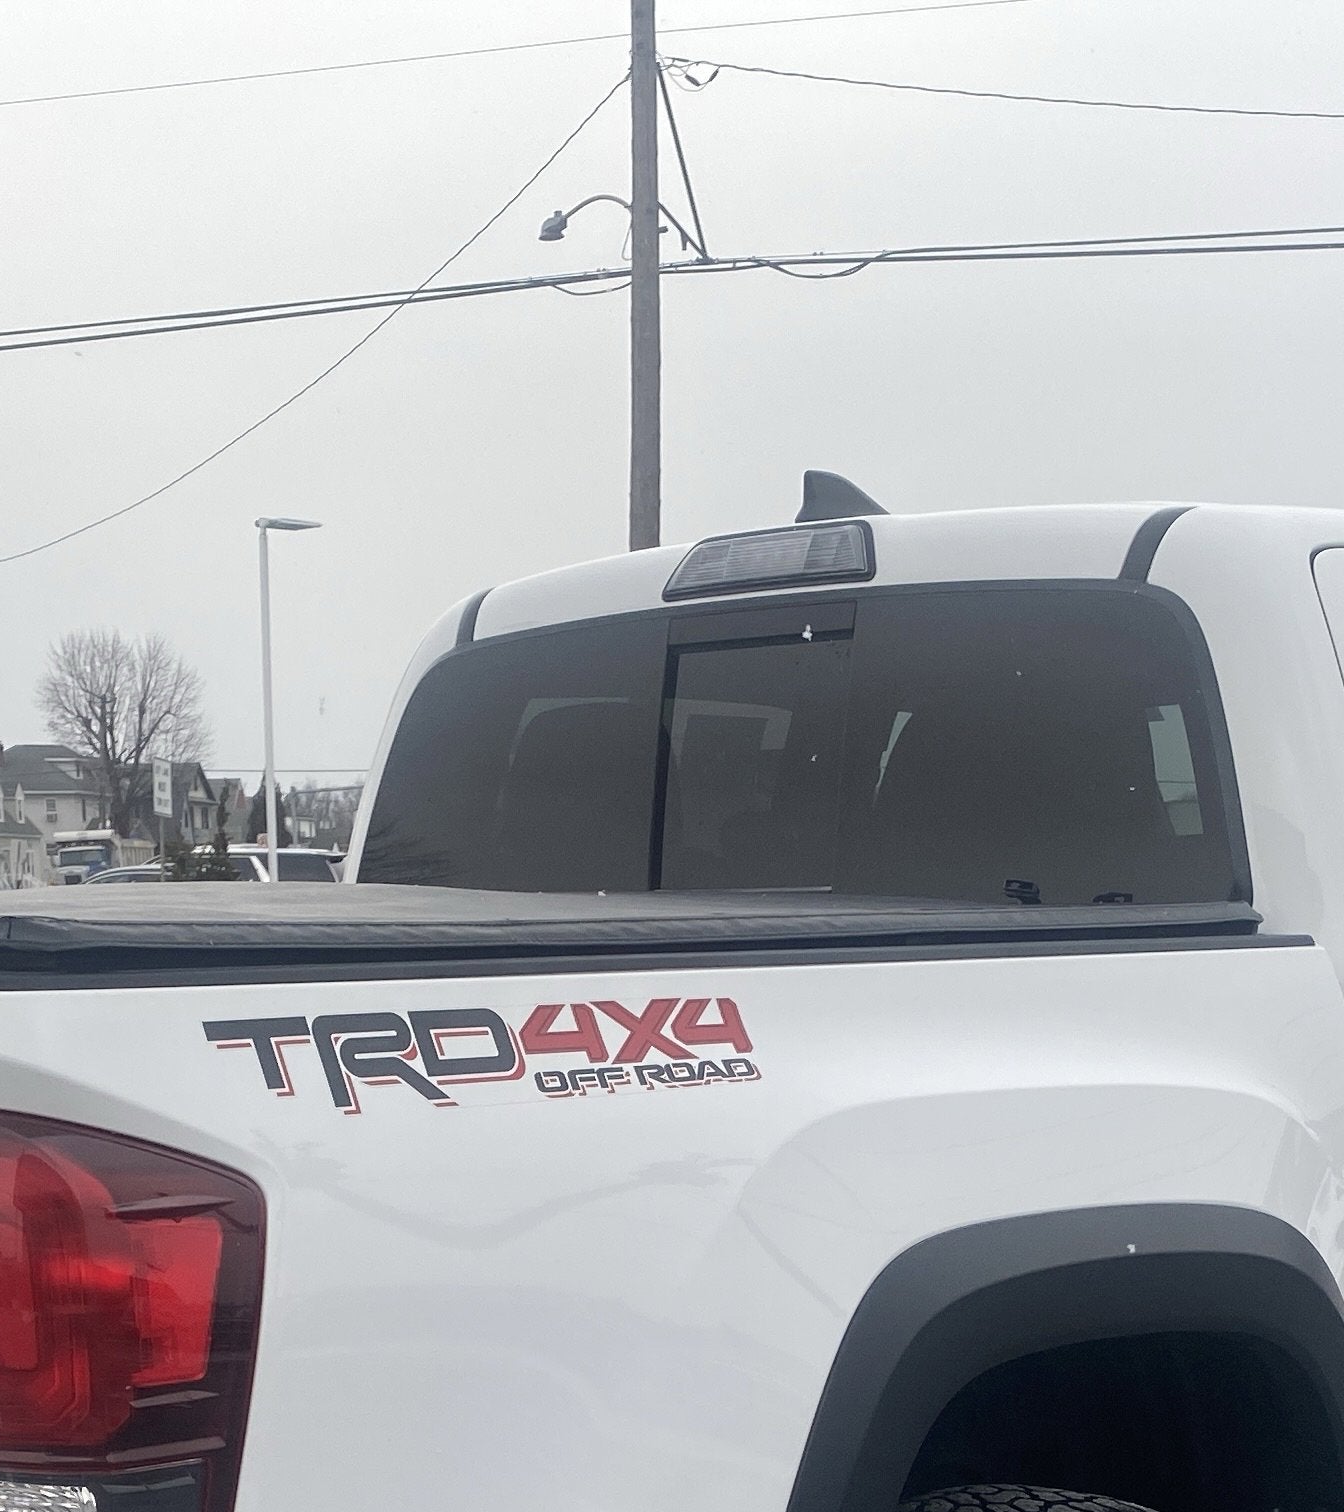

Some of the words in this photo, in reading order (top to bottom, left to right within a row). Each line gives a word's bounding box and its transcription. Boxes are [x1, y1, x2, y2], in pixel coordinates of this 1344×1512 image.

[202, 1007, 527, 1115] TRD
[534, 1067, 630, 1098] OFF
[635, 1056, 763, 1090] ROAD
